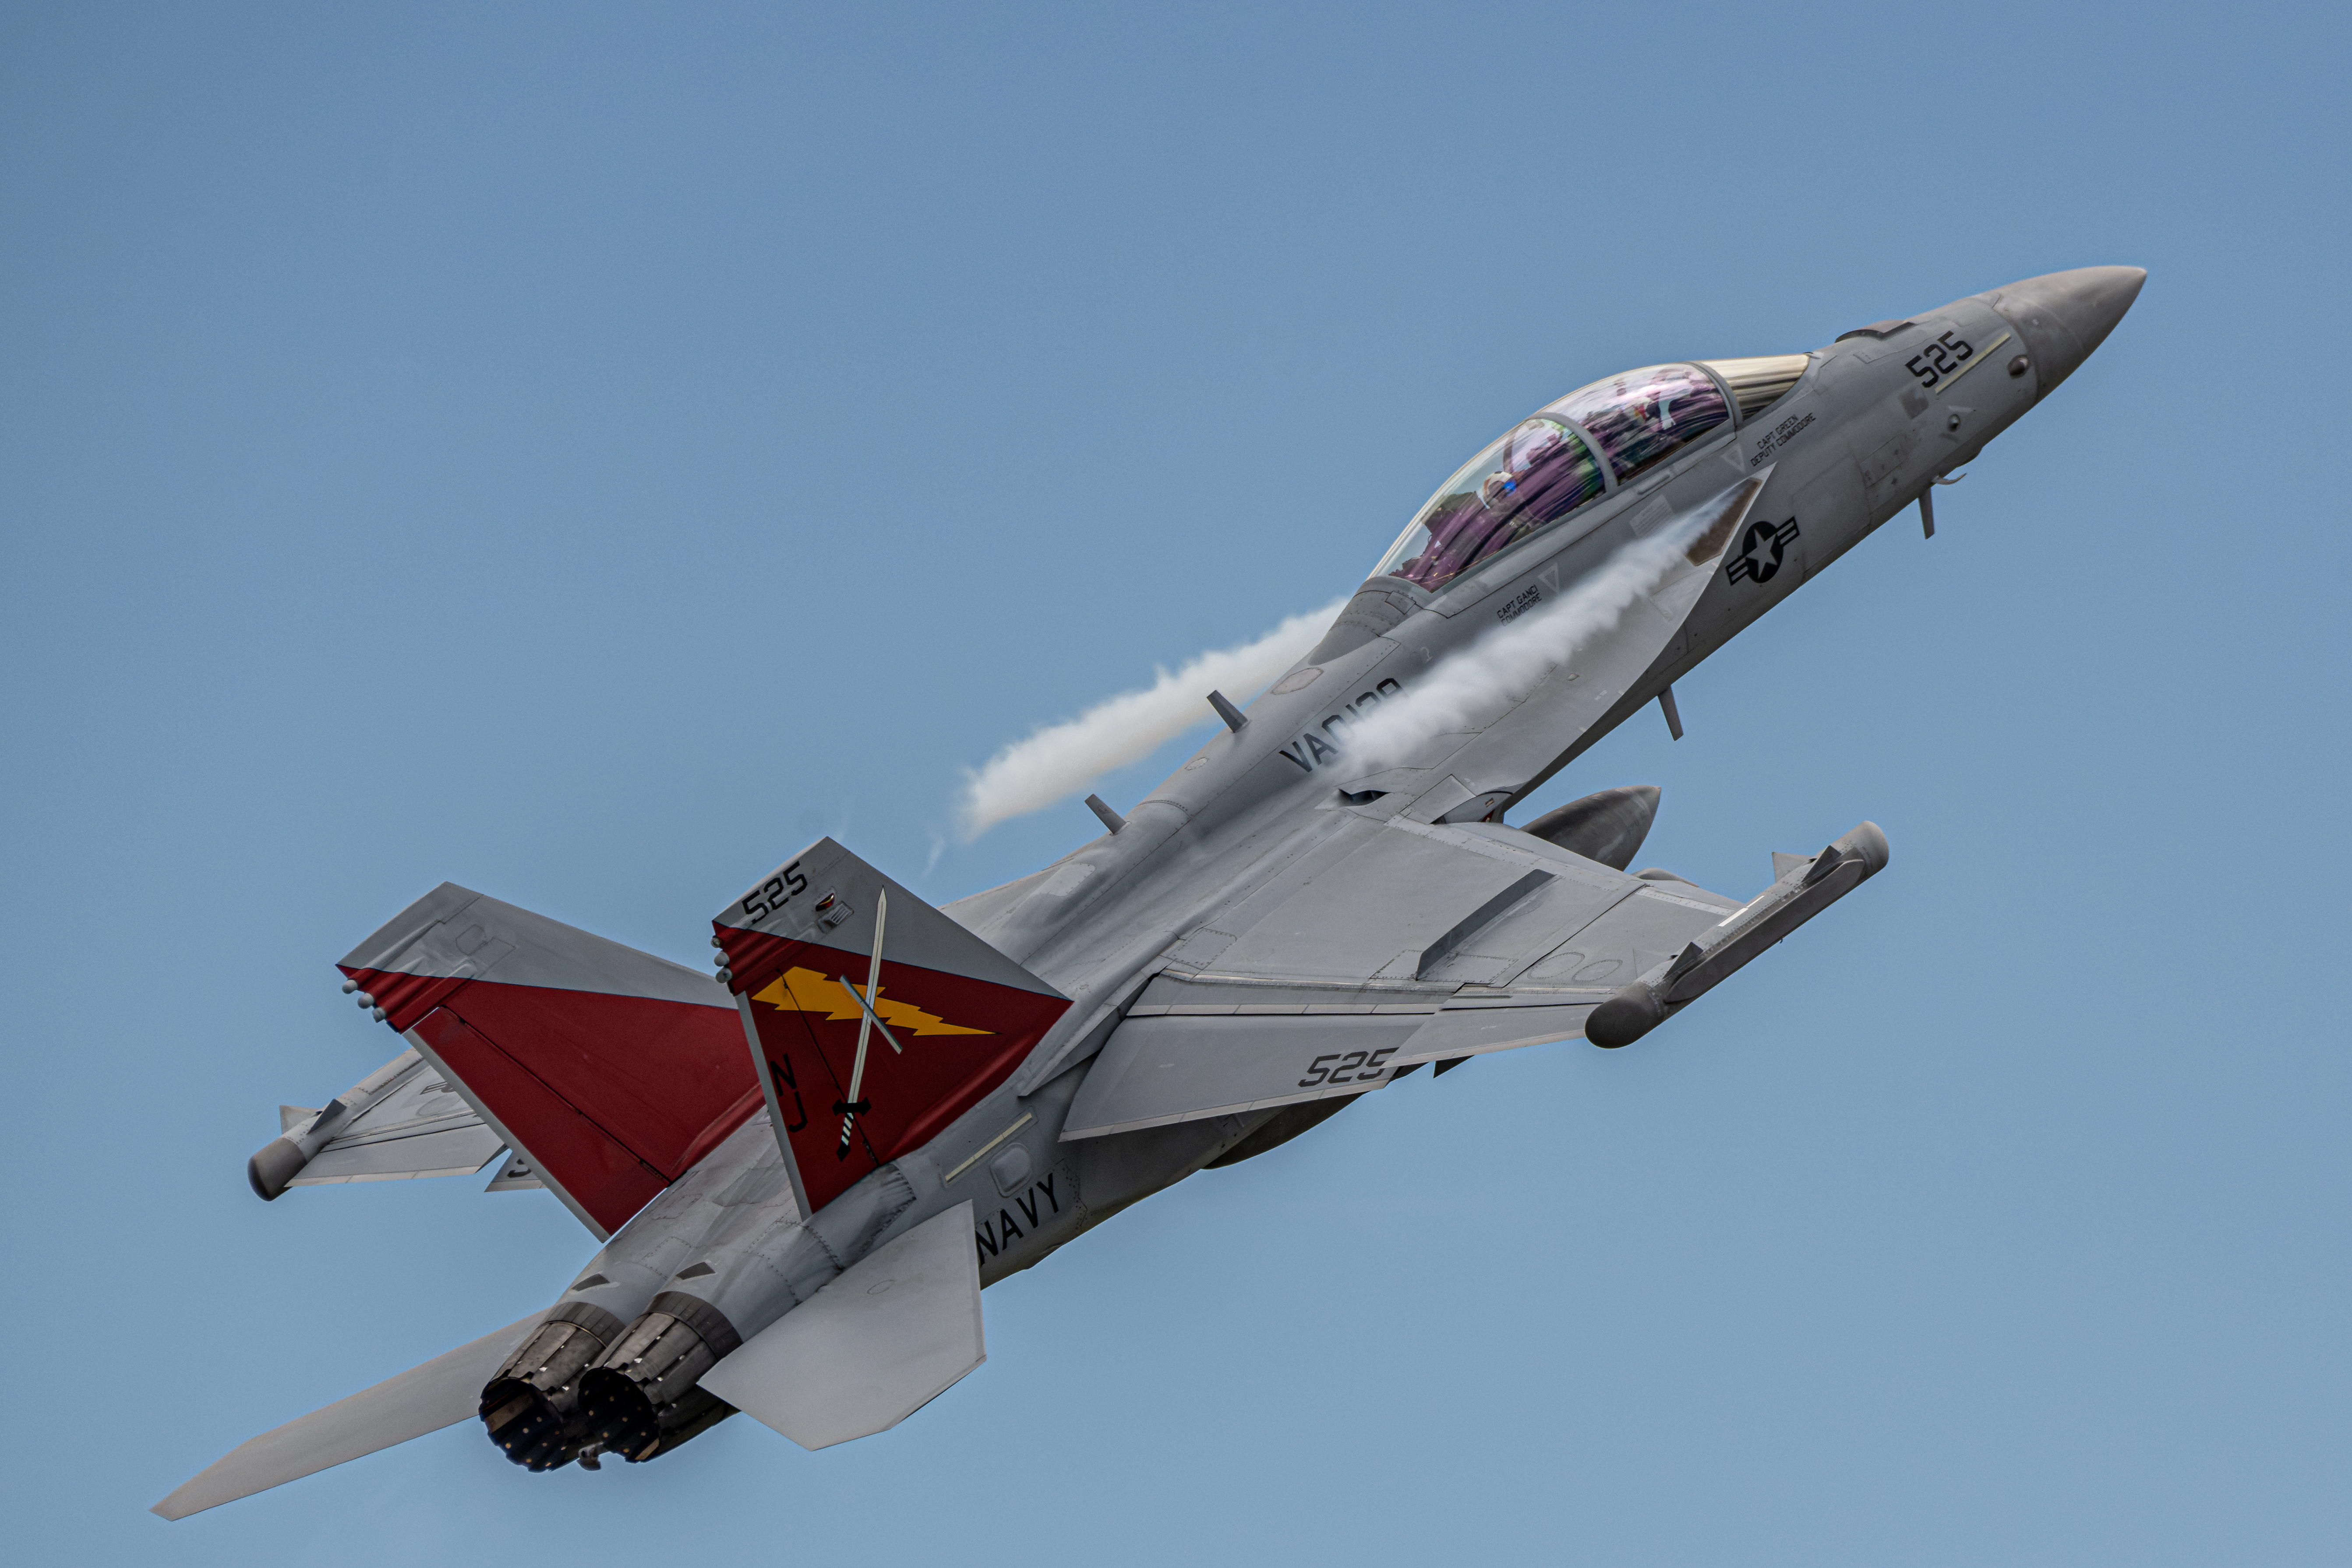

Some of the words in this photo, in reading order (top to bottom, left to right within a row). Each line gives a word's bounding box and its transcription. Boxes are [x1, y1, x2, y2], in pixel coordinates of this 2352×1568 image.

[1905, 330, 1973, 388] 525
[1750, 442, 1776, 467] DEPUTY
[1776, 413, 1816, 446] COMMODORE
[1757, 431, 1776, 449] CAPT
[1775, 414, 1798, 435] GREEN
[1497, 600, 1515, 618] CAPT
[1516, 584, 1538, 604] GANCI
[1501, 592, 1542, 626] COMMODORE
[741, 860, 808, 924] 525
[770, 1053, 797, 1096] N
[1297, 1046, 1400, 1088] 525
[788, 1091, 808, 1133] J
[975, 1172, 1059, 1267] NAVY
